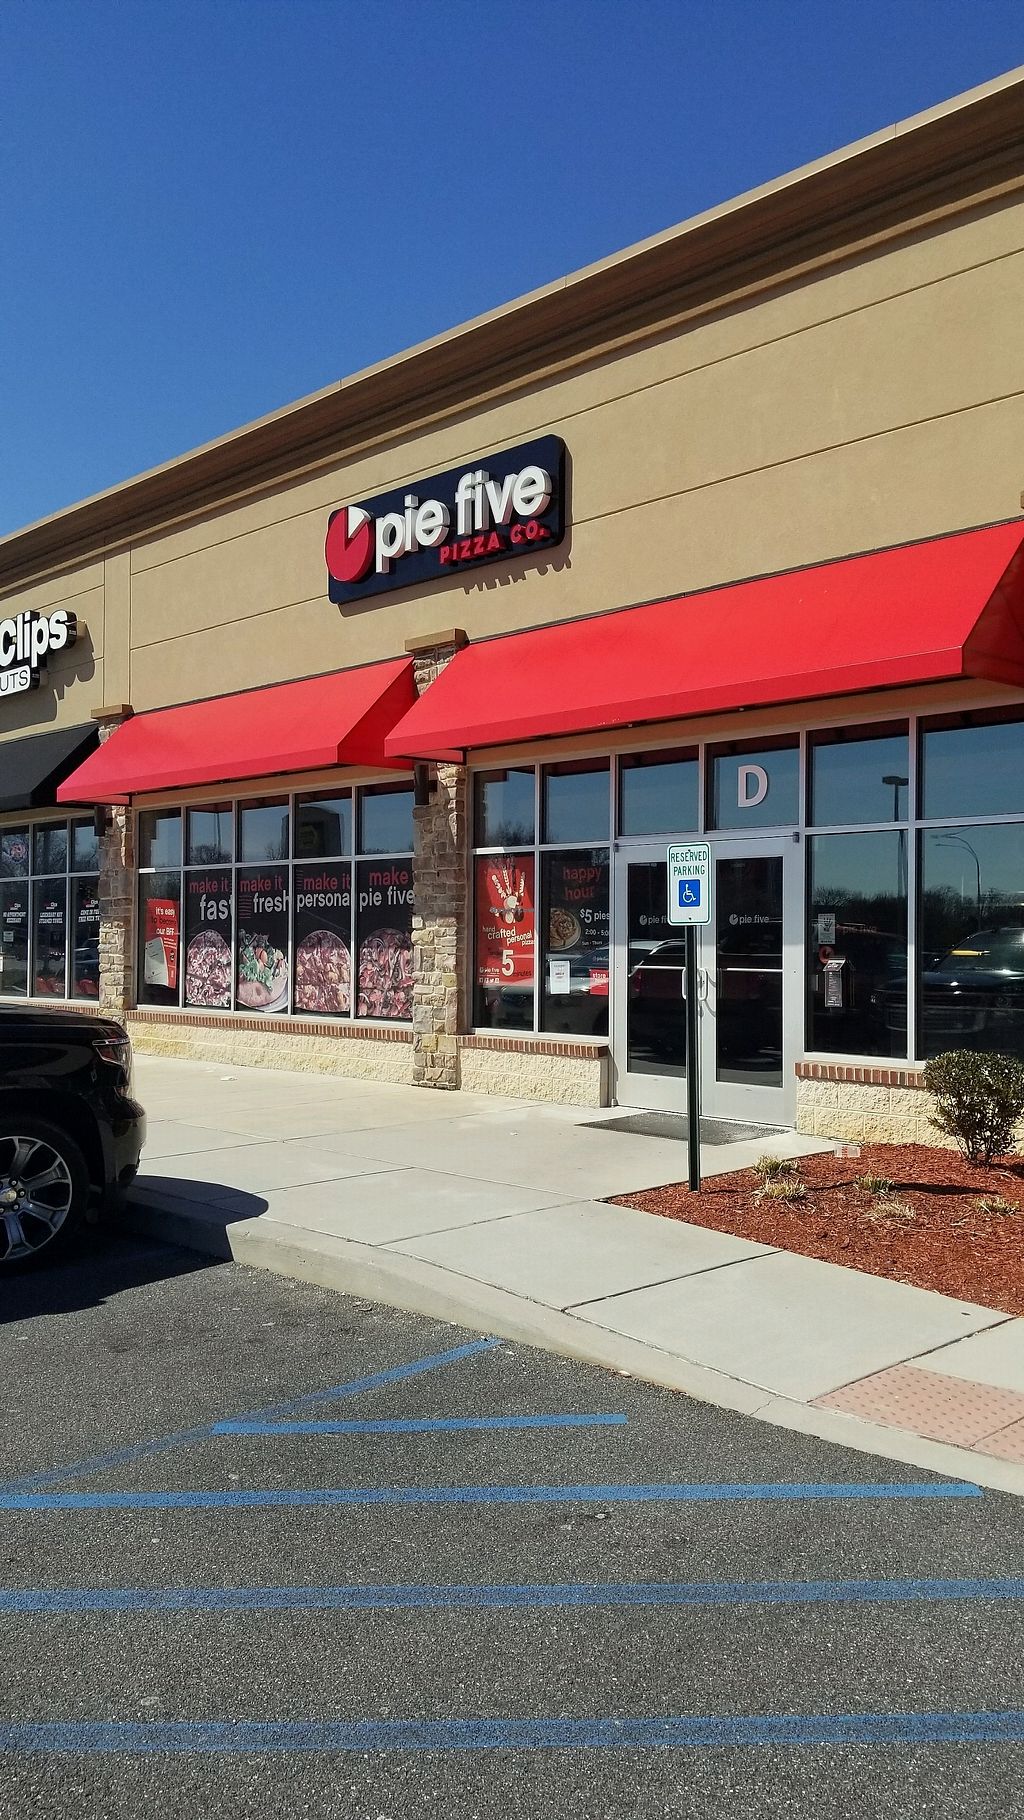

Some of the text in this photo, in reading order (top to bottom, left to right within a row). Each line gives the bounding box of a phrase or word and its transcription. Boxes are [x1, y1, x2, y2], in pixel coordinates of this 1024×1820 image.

[376, 465, 552, 574] pie five
[439, 520, 550, 565] PIZZA CO.
[0, 669, 28, 692] UTS
[737, 764, 768, 808] D
[670, 850, 708, 863] RESERVED
[368, 866, 409, 886] make
[563, 867, 601, 883] happy
[673, 864, 706, 876] PARKING
[190, 877, 229, 893] make it
[240, 875, 283, 892] make it
[303, 872, 351, 891] make it
[253, 889, 290, 913] fresh
[360, 886, 416, 912] pie five
[565, 887, 594, 899] hour
[580, 908, 611, 923] $5 pies
[649, 916, 660, 925] pie
[739, 915, 770, 925] pie five
[488, 926, 516, 940] crafted
[506, 930, 533, 946] personal
[501, 950, 514, 976] 5
